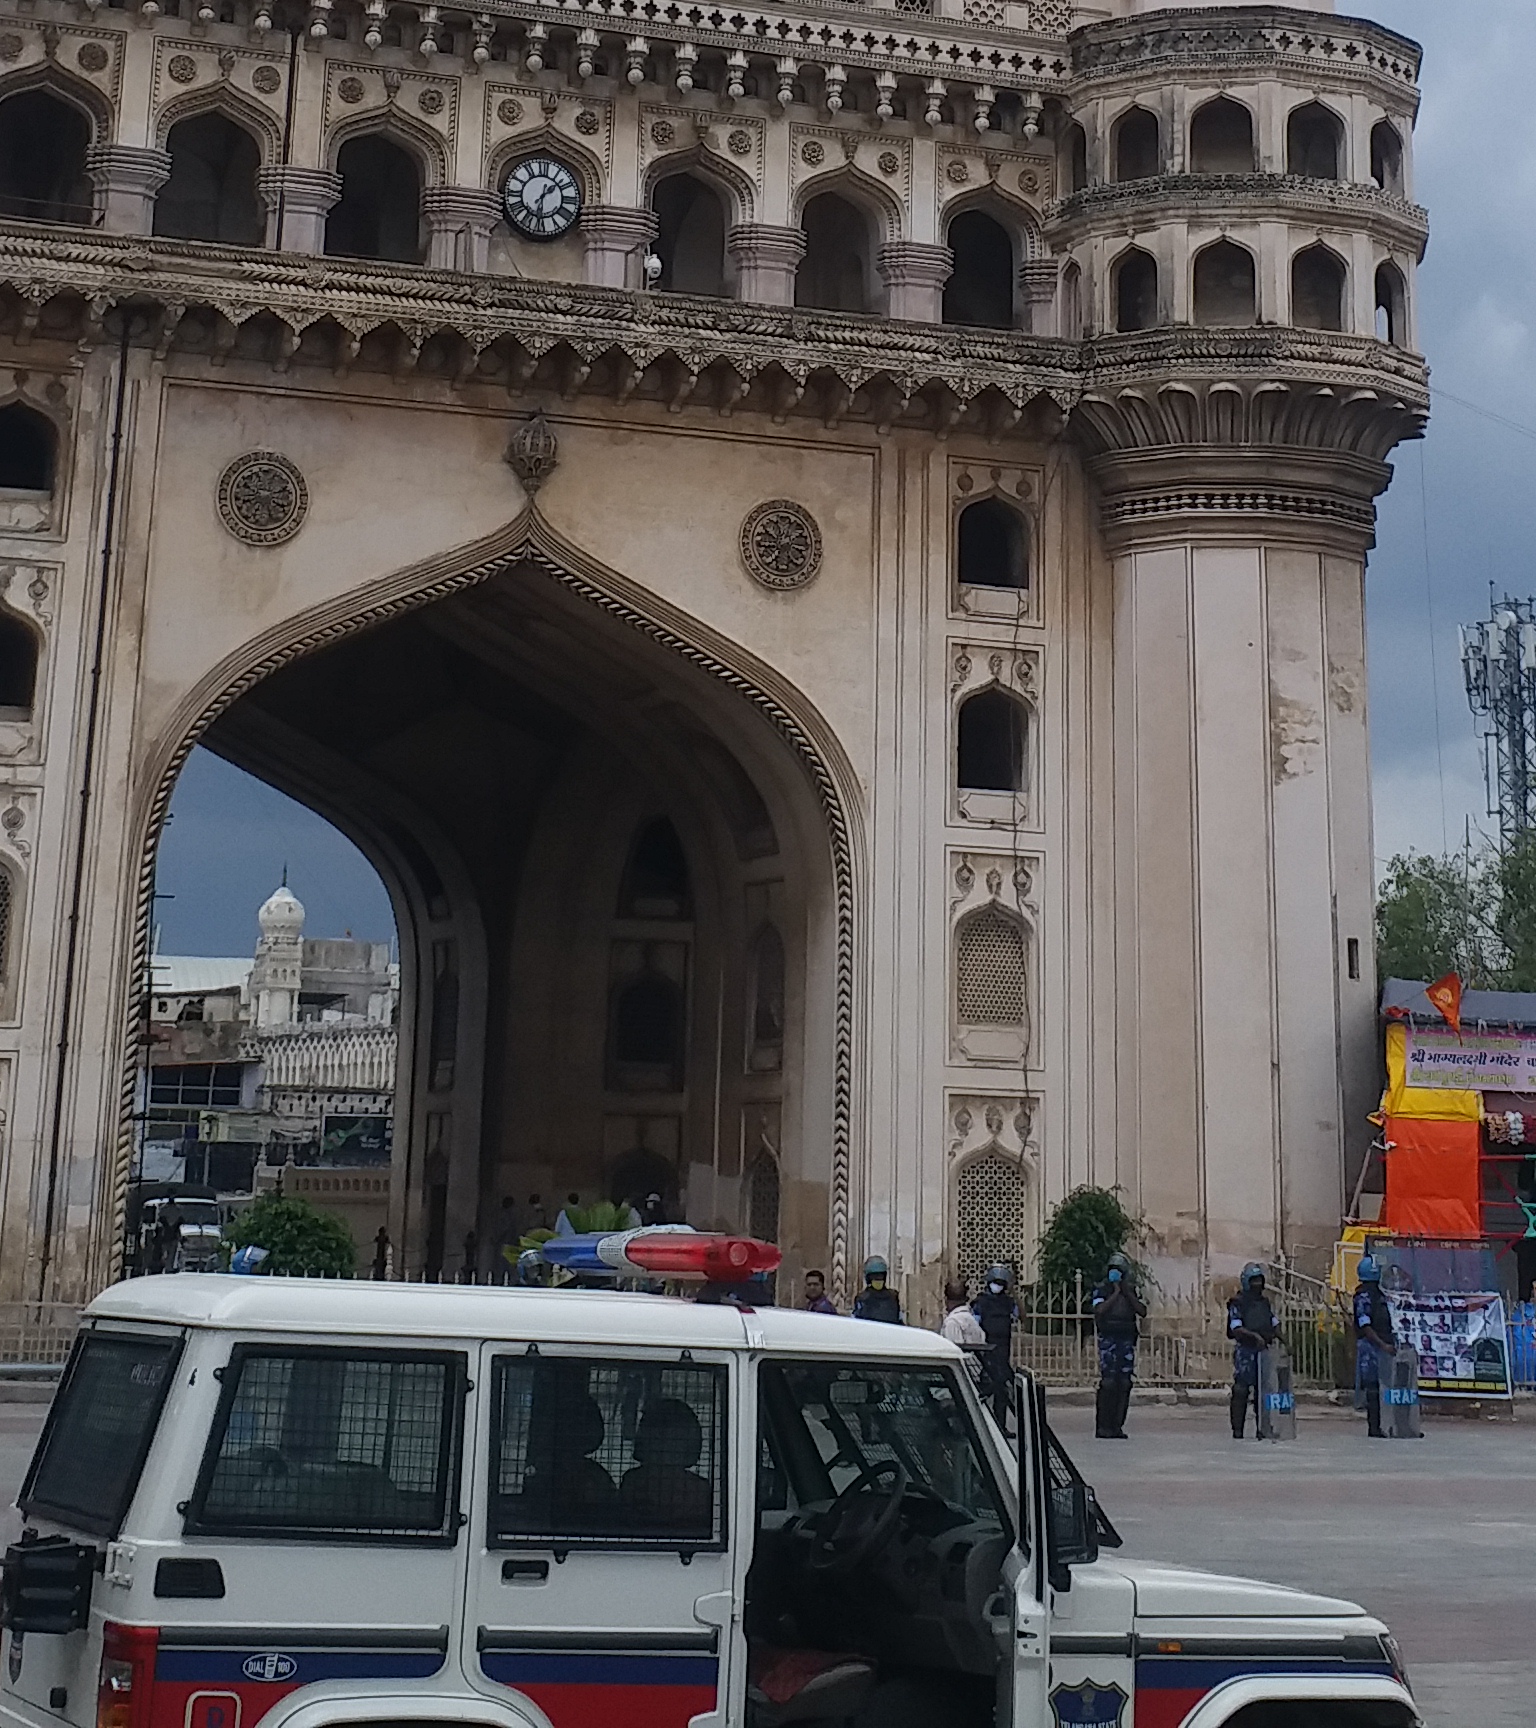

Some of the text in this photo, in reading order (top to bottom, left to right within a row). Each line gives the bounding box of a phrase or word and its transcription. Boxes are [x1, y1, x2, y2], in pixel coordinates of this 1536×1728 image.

[1410, 1048, 1426, 1063] श्री
[248, 1661, 291, 1674] DIAL 100
